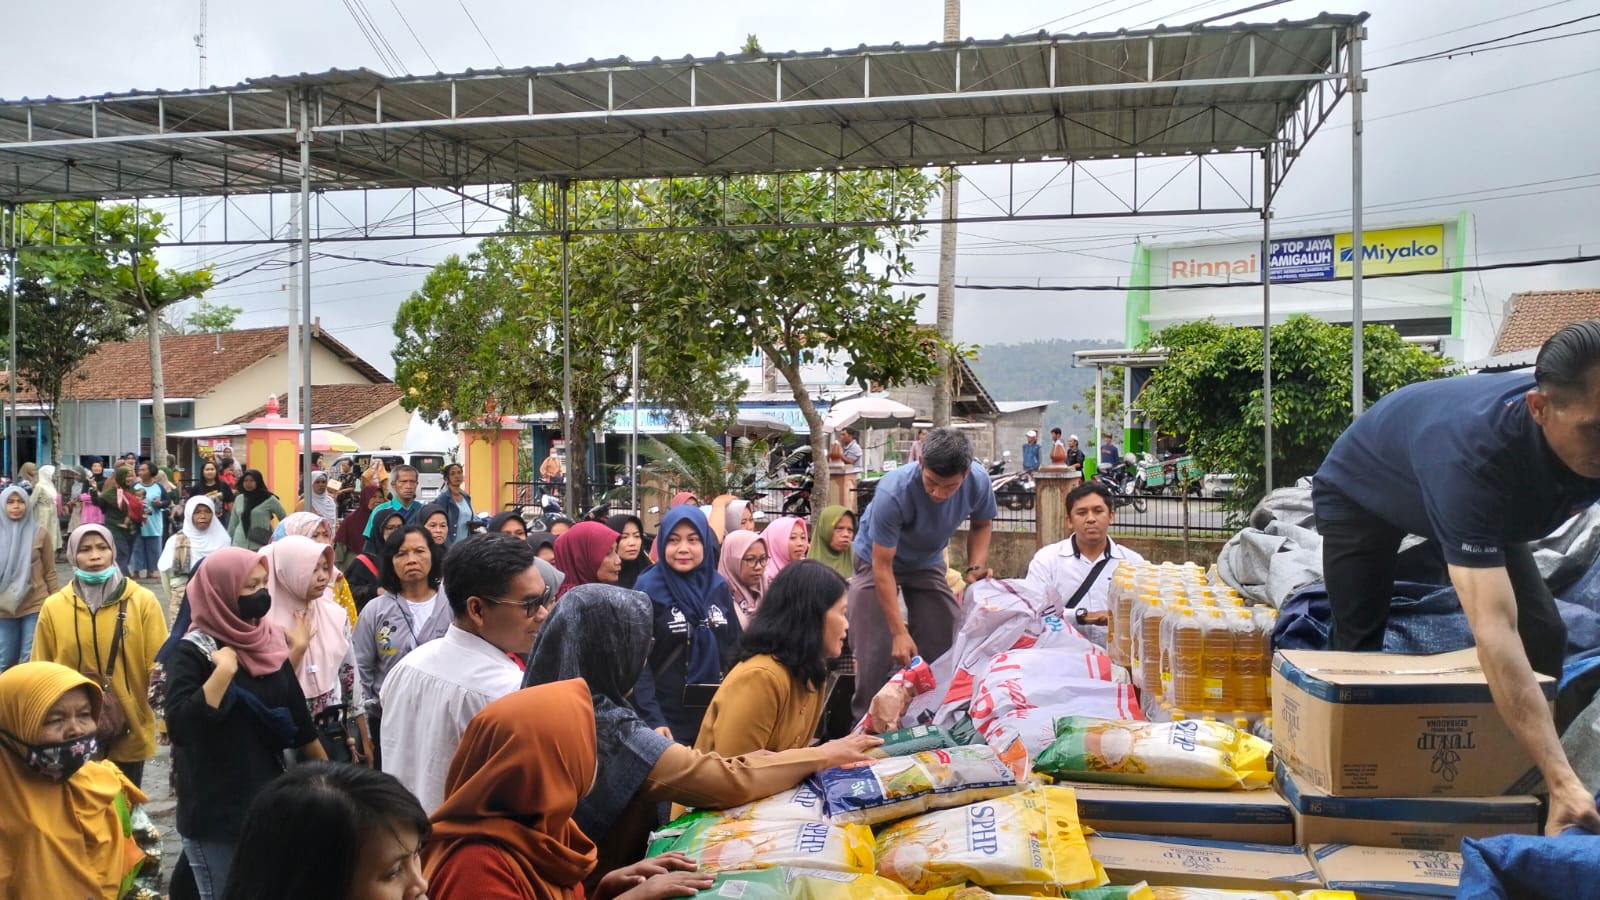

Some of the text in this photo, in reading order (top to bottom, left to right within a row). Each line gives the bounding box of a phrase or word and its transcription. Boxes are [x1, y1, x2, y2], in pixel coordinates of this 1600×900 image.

[1282, 241, 1304, 253] TOP
[1306, 239, 1332, 251] JAYA
[1362, 240, 1438, 264] Miyako
[1171, 254, 1256, 279] Rinnai
[1268, 252, 1331, 267] AMIGALUH
[1173, 721, 1198, 751] SPHP
[1417, 731, 1476, 750] TULIP
[800, 823, 829, 852] SPHP
[970, 806, 998, 854] SPHP
[1031, 840, 1043, 868] BULOG
